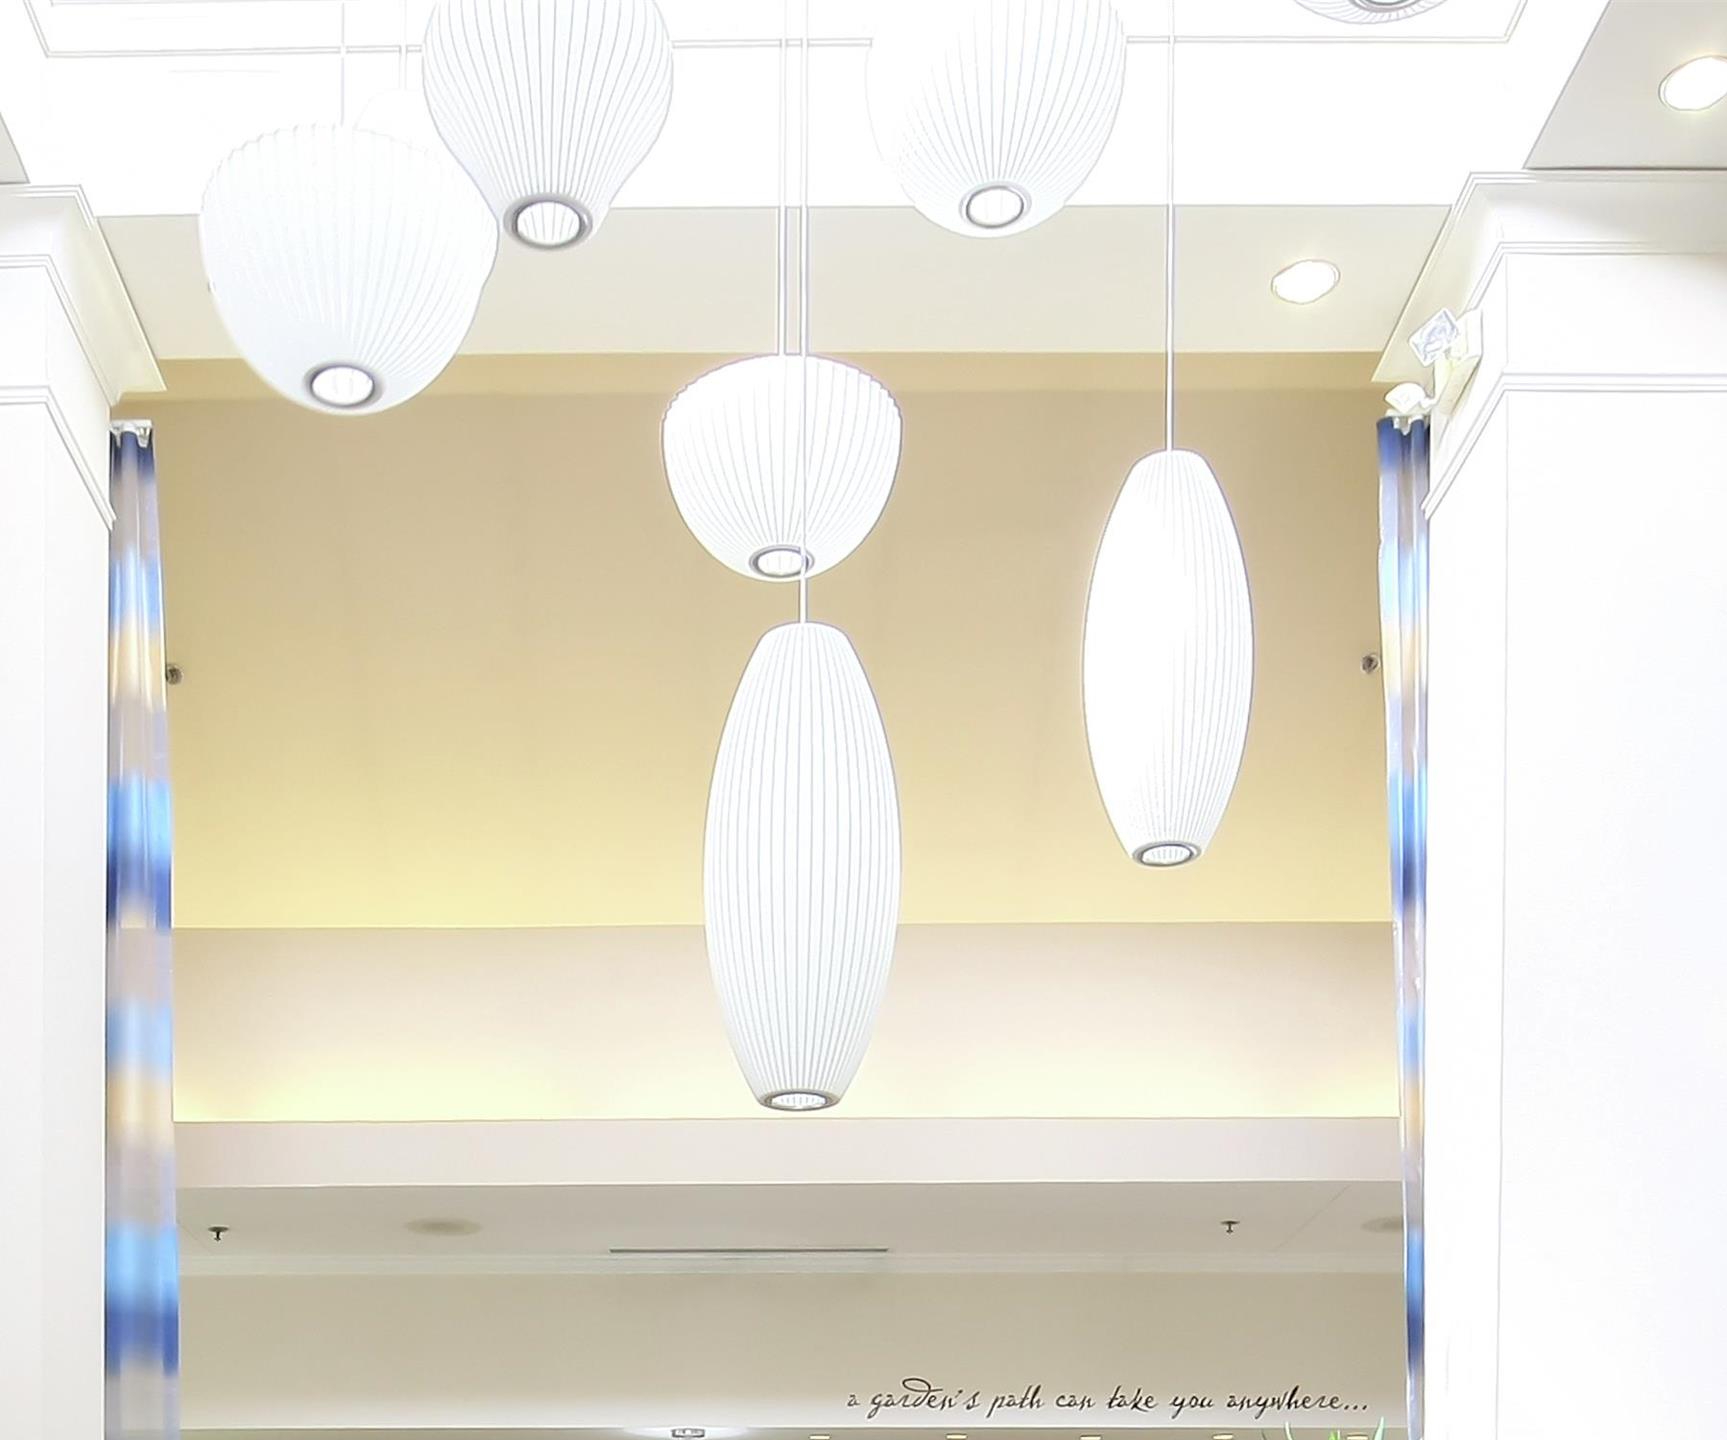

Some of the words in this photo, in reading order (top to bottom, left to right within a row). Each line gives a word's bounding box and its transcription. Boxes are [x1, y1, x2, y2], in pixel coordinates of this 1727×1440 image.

[847, 1394, 860, 1407] a
[867, 1378, 981, 1419] garden's
[986, 1384, 1044, 1419] path
[1056, 1395, 1096, 1411] can
[1106, 1385, 1158, 1413] take
[1169, 1395, 1214, 1420] you
[1227, 1385, 1368, 1420] anywhere...
